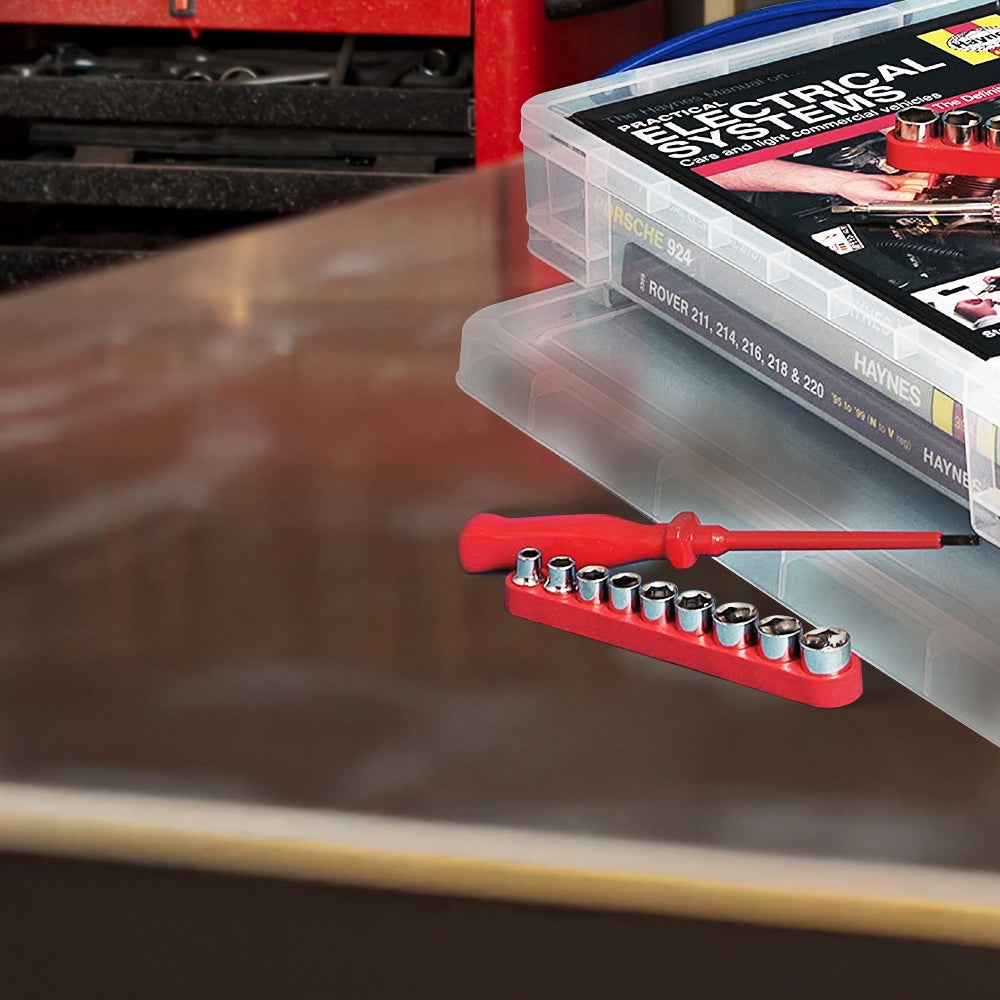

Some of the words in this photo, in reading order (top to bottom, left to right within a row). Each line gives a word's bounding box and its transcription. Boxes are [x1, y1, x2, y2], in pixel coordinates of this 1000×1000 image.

[601, 112, 638, 125] The
[703, 78, 765, 100] Manual
[616, 100, 729, 133] PRACTICAL
[630, 57, 947, 146] ELECTRICAL
[657, 85, 907, 159] SYSTEMS
[931, 100, 962, 111] The
[679, 152, 720, 168] Cars
[722, 143, 753, 156] and
[753, 133, 792, 149] light
[791, 109, 880, 138] commercial
[879, 92, 943, 114] vehicles
[667, 238, 692, 266] 924
[649, 279, 689, 317] ROVER
[691, 307, 714, 334] 211,
[716, 321, 739, 350] 214,
[742, 337, 765, 366] 216,
[767, 353, 789, 378] 218
[791, 367, 800, 385] &
[803, 374, 825, 398] 220
[854, 351, 922, 407] HAYNES
